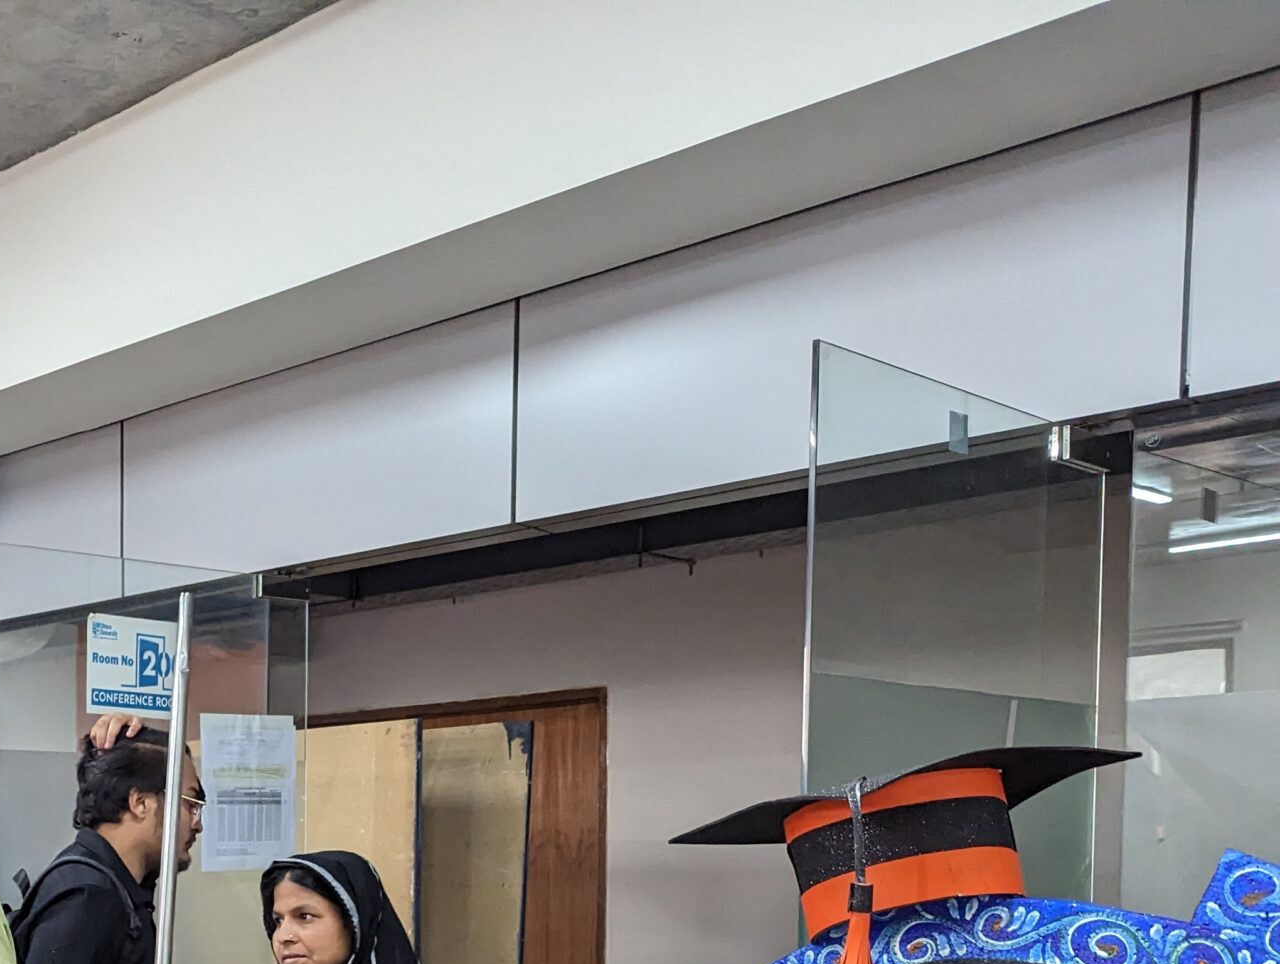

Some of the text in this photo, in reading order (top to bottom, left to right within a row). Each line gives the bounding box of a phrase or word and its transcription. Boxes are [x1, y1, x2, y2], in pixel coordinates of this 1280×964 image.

[92, 650, 177, 679] Room No 20
[93, 690, 173, 708] CONFERENCE ROO
